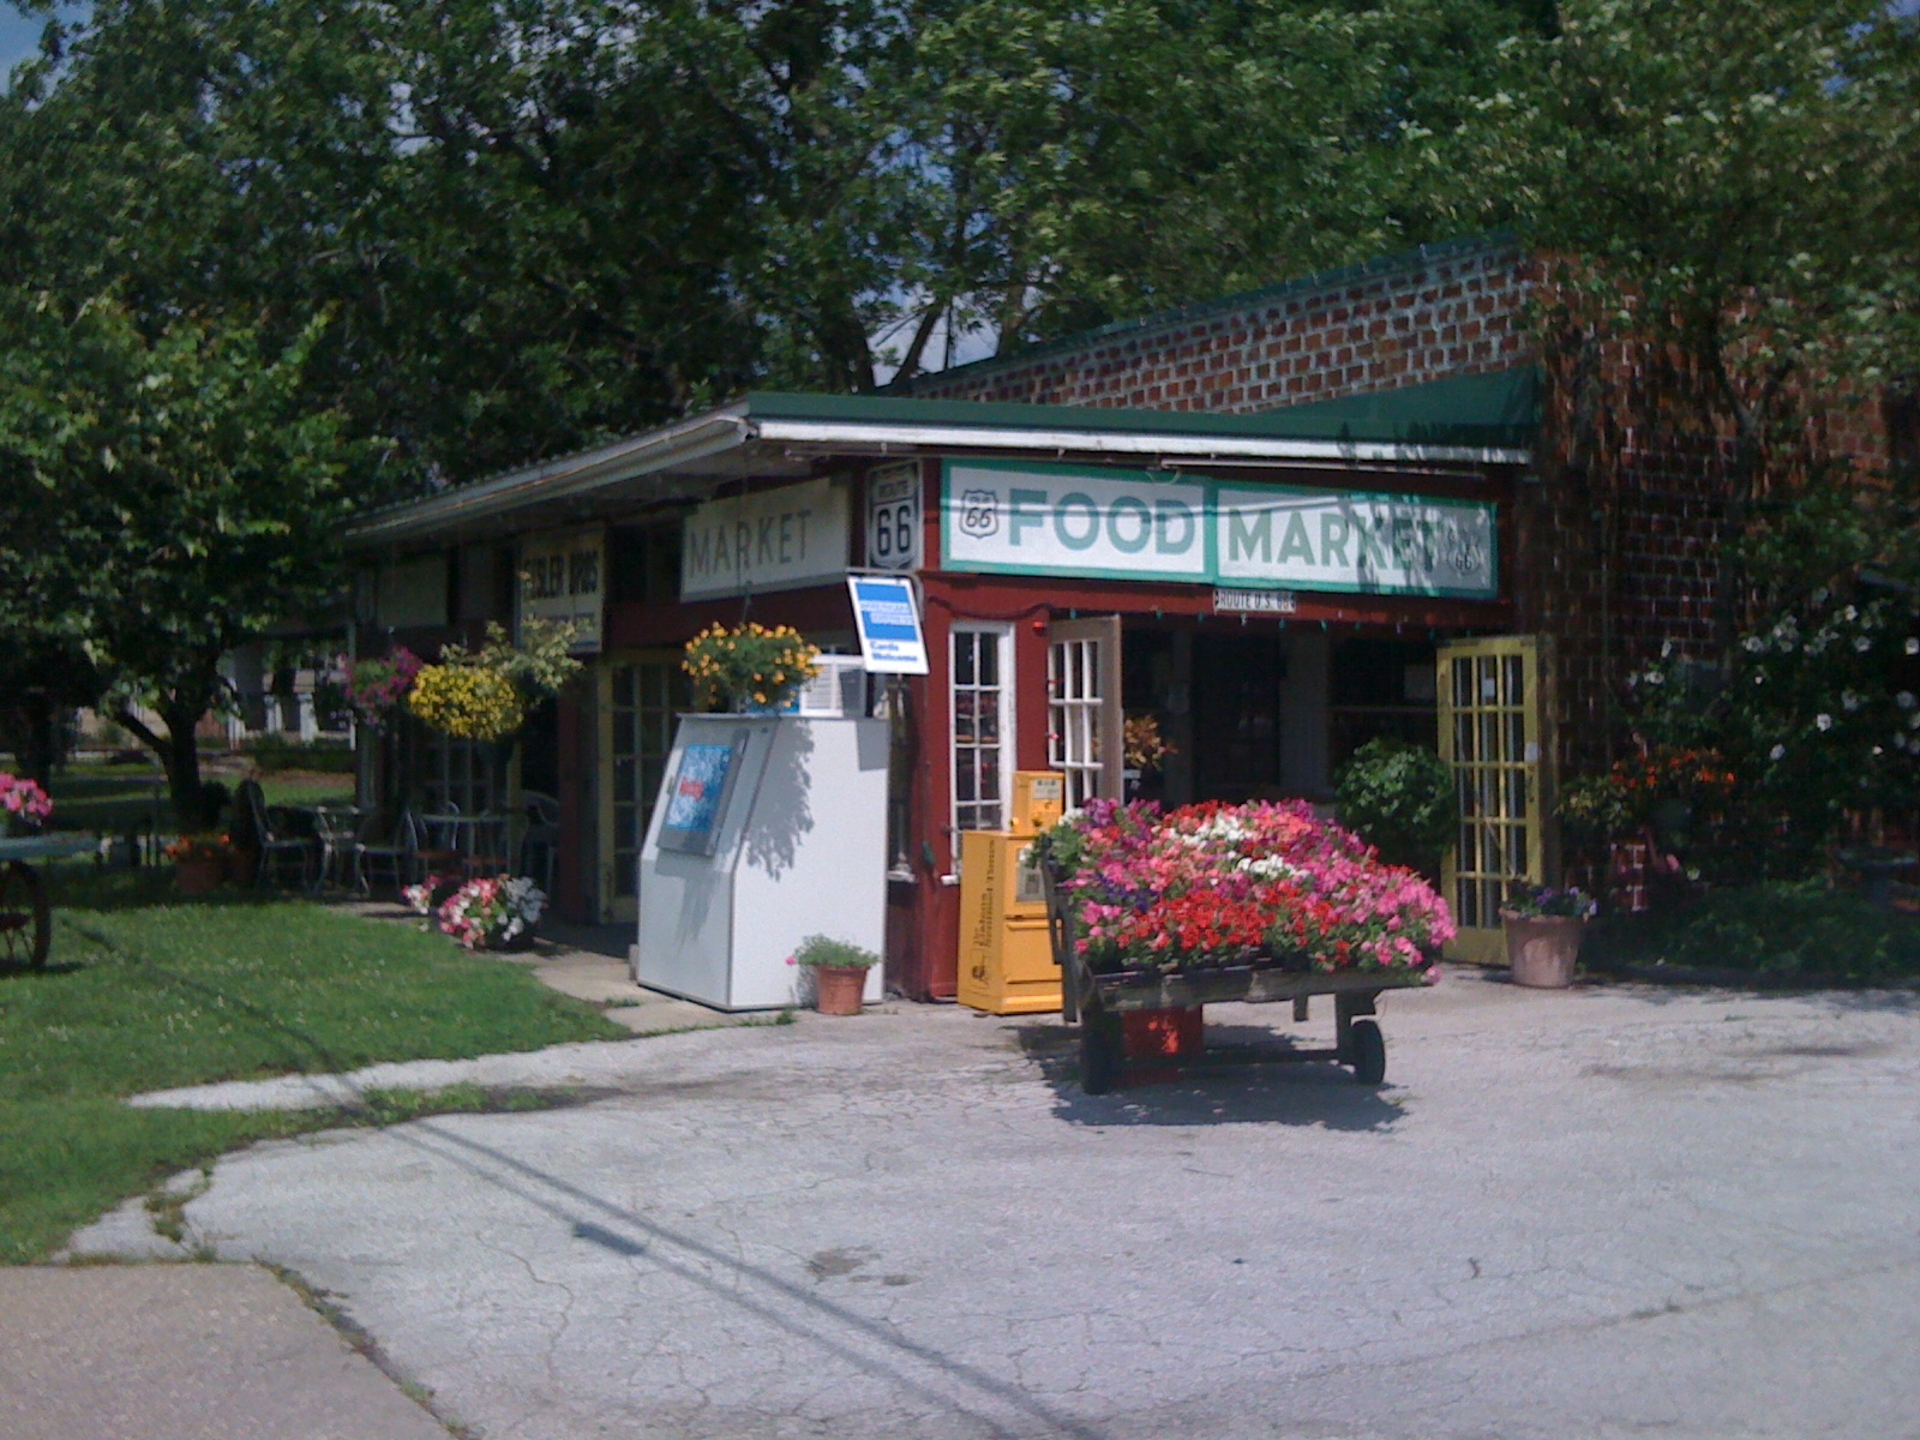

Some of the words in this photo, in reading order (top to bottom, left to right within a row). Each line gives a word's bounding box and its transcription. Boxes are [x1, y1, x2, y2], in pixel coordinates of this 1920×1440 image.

[690, 509, 812, 579] MARKET
[876, 505, 911, 556] 66
[965, 506, 993, 529] 66
[1009, 487, 1196, 555] FOOD
[1229, 508, 1435, 573] MARKET
[1219, 591, 1252, 608] ROUTE
